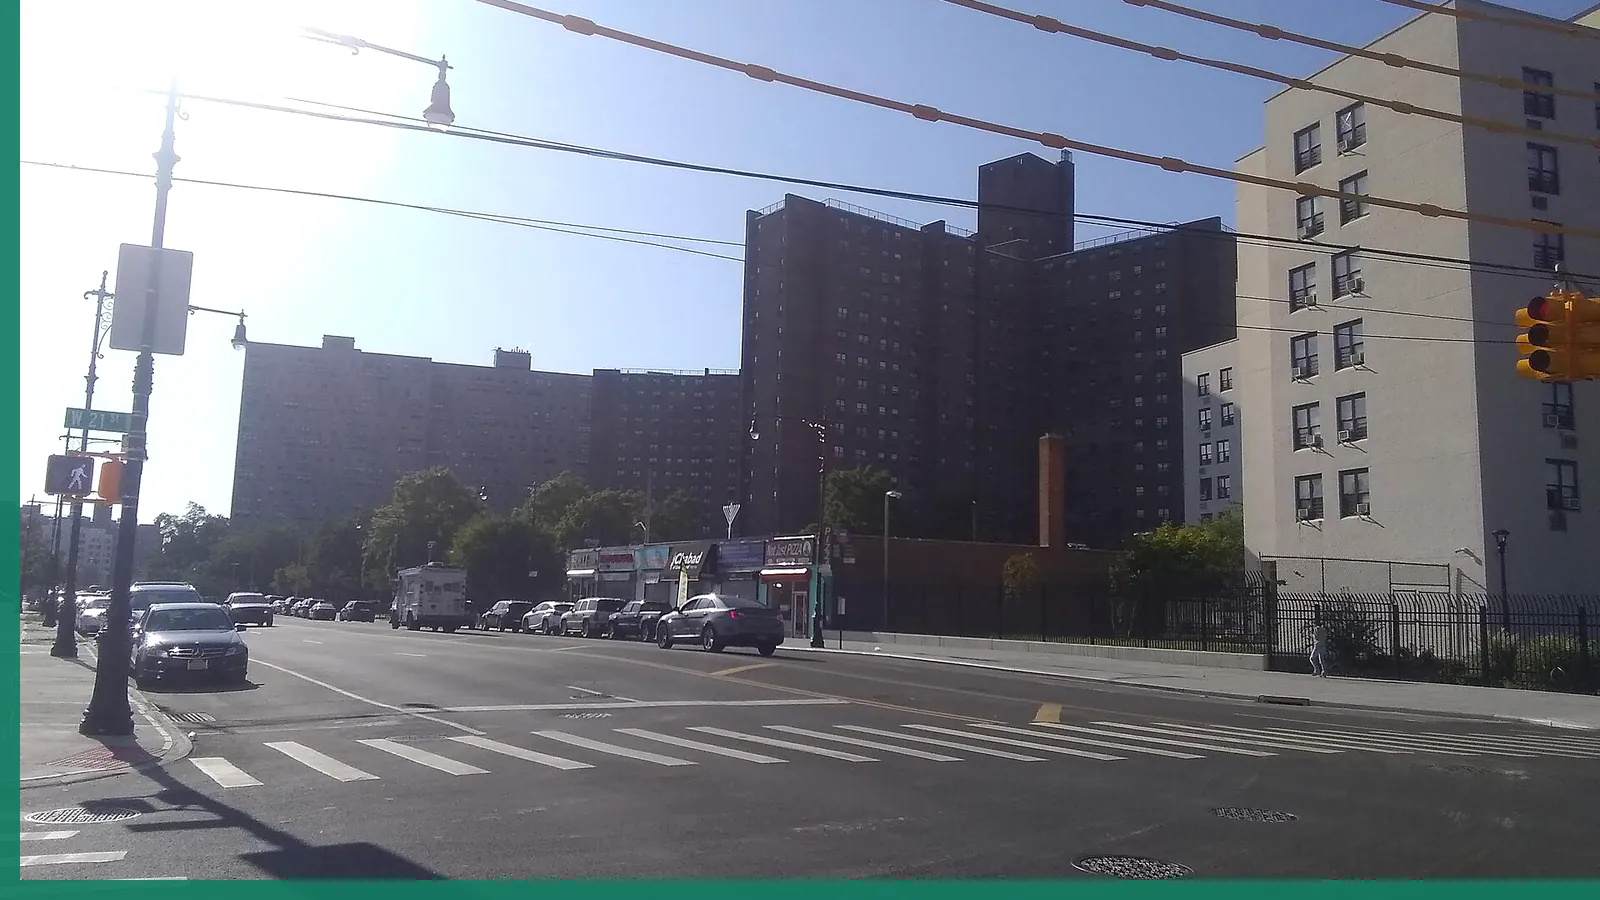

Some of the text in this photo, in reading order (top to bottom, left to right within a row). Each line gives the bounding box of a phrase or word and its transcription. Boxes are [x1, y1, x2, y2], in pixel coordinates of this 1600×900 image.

[72, 410, 83, 427] W
[88, 412, 105, 429] 21
[673, 551, 703, 565] Chabad
